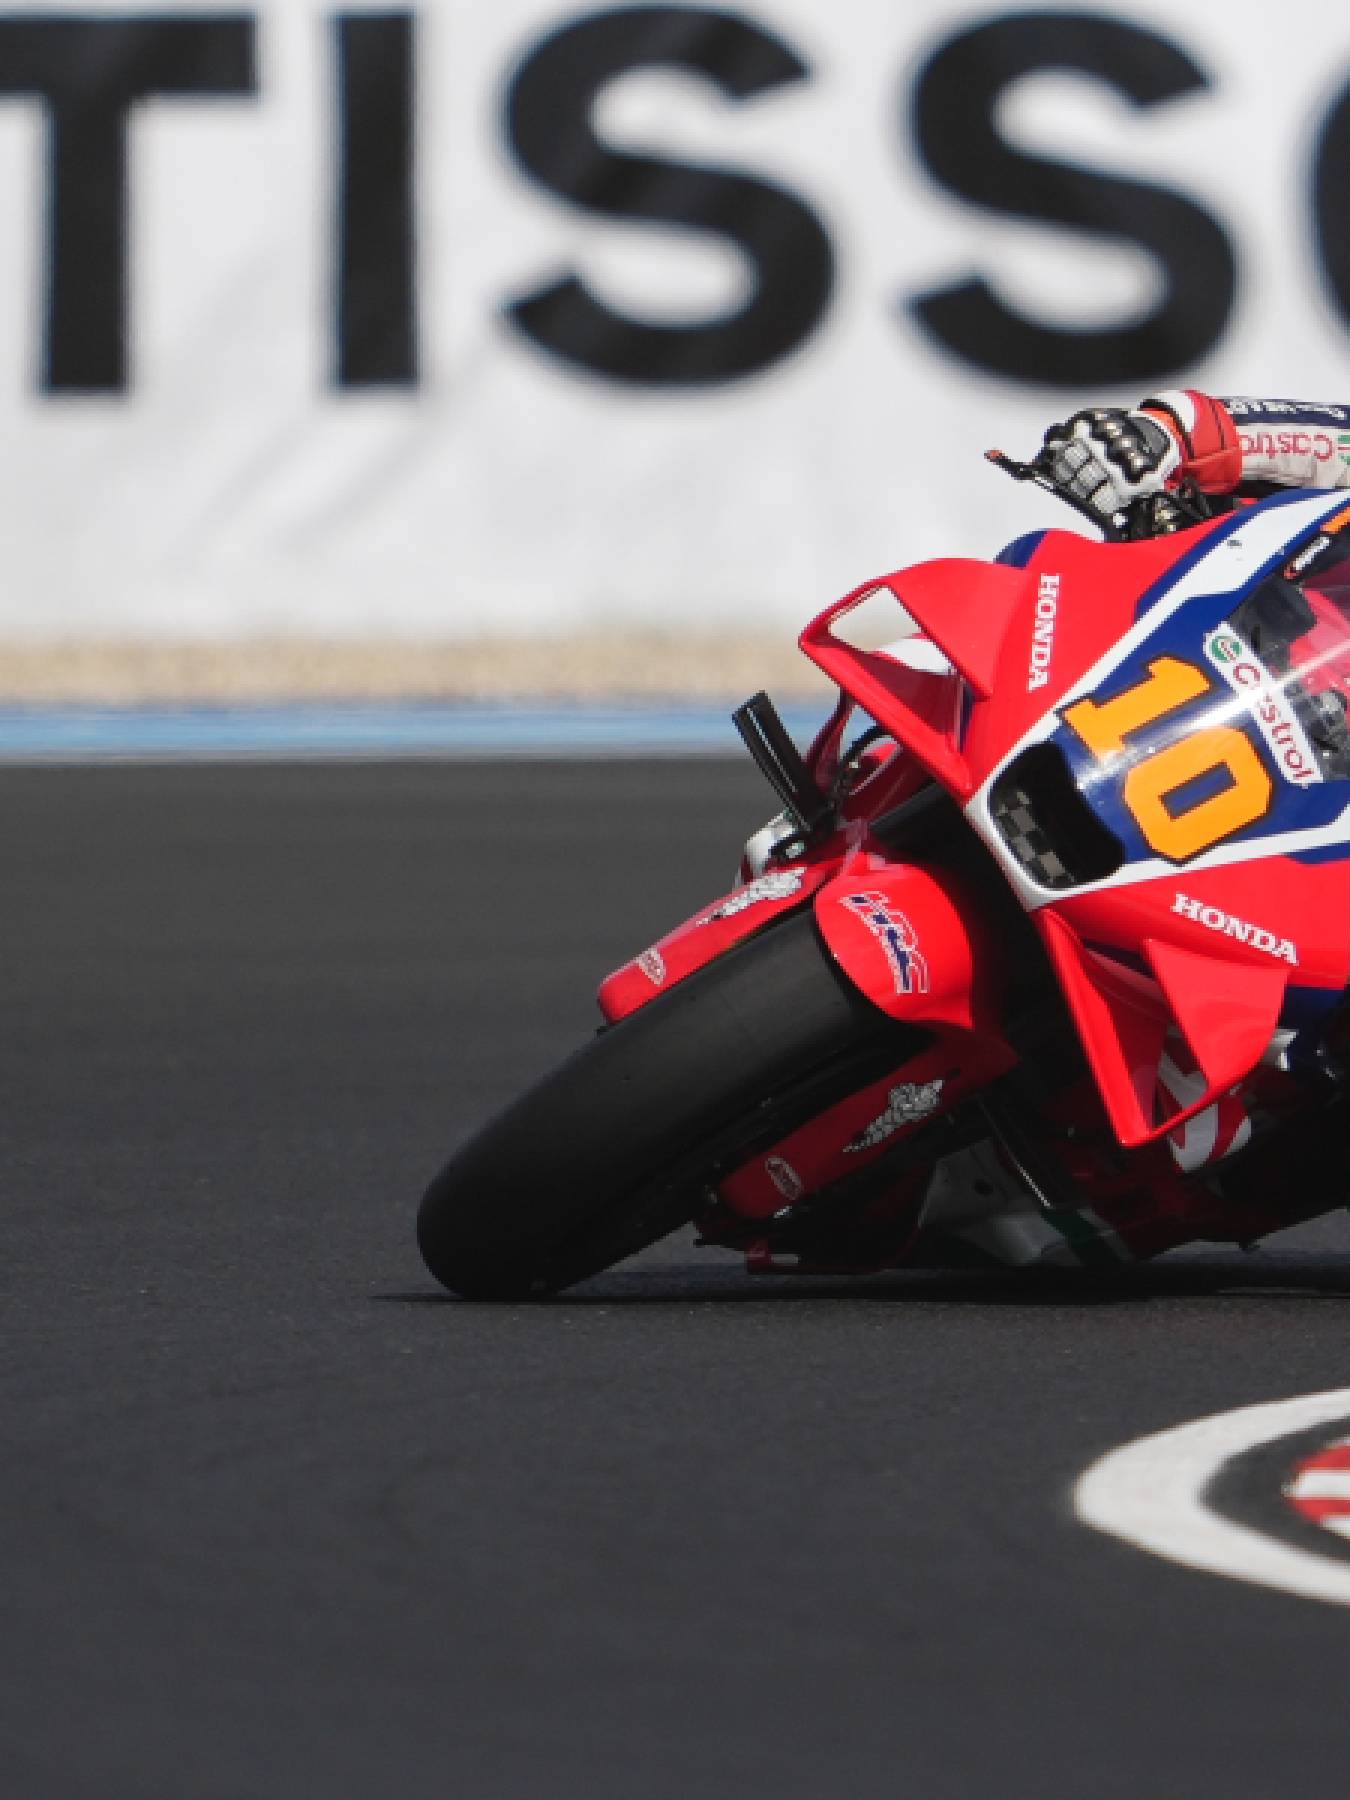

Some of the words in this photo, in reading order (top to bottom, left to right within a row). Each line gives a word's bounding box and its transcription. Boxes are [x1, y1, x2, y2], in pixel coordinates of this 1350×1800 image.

[1027, 572, 1061, 692] HONDA
[1060, 655, 1274, 864] 10
[1232, 662, 1314, 778] Cstrol
[838, 890, 929, 994] HRC
[1169, 891, 1300, 966] HONDA
